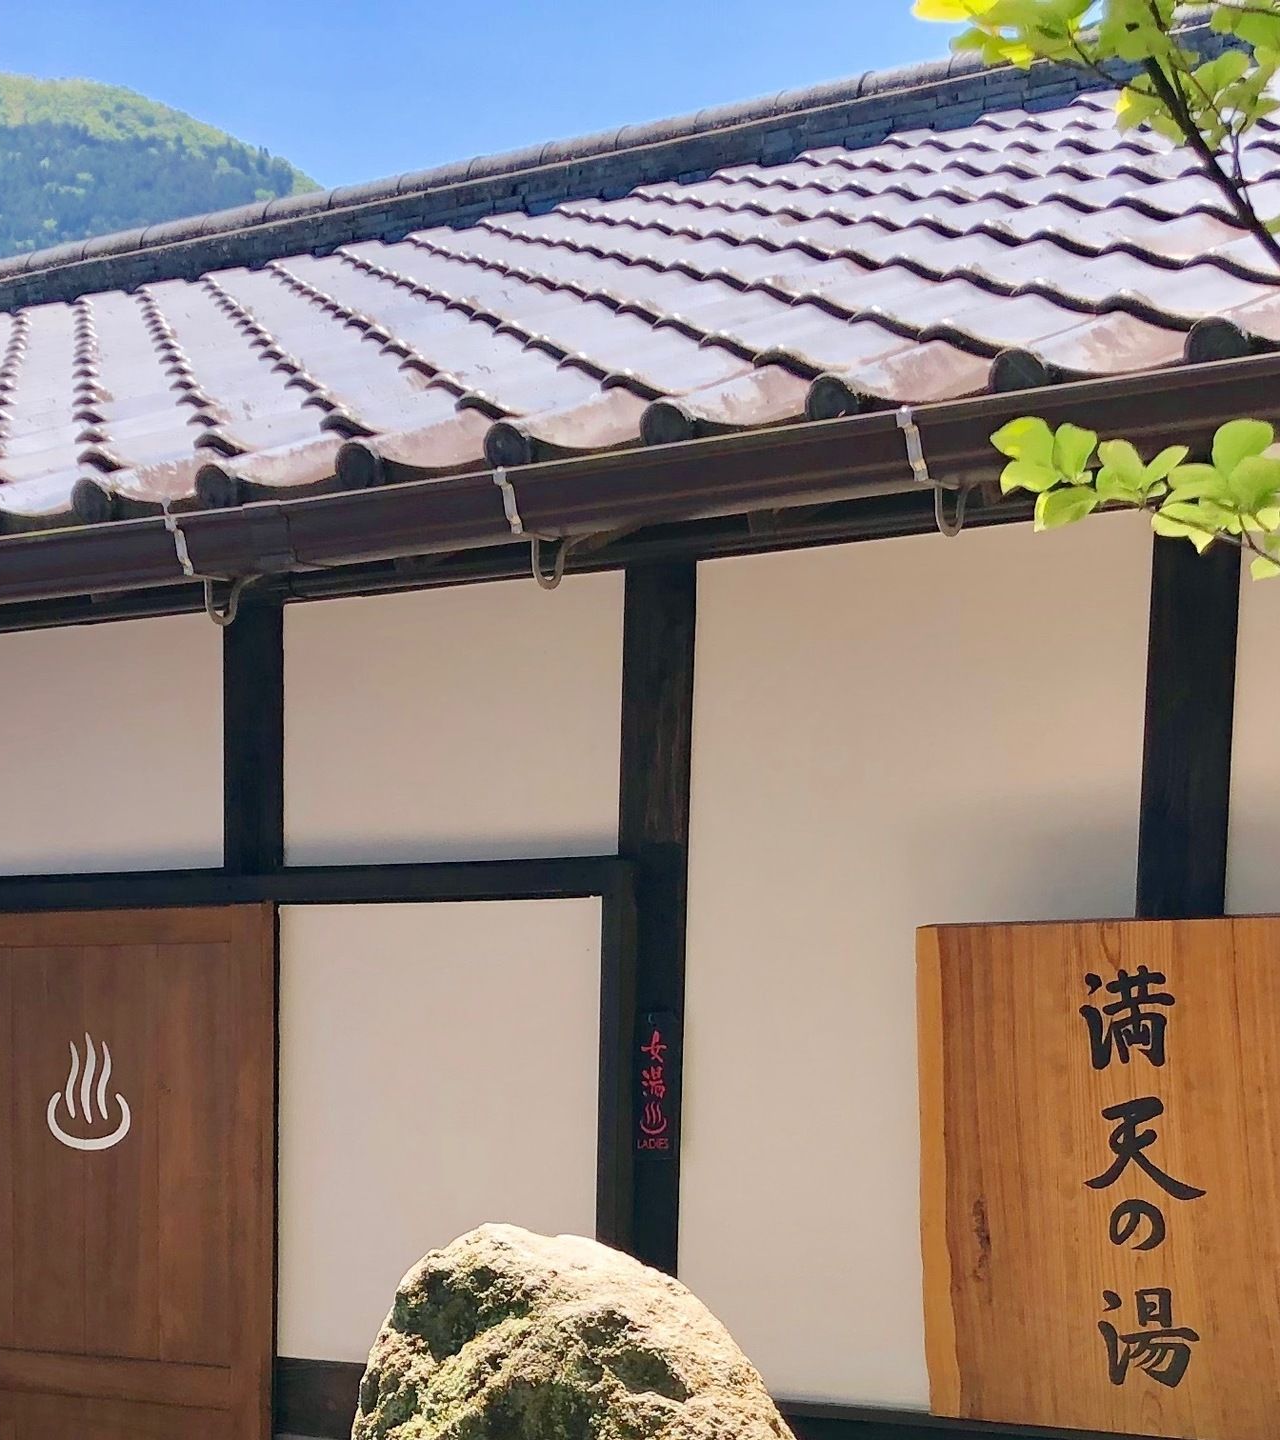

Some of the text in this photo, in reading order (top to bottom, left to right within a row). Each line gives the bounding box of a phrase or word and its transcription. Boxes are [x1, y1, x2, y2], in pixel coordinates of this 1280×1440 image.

[640, 1029, 668, 1099] 女湯
[1078, 964, 1207, 1388] 満天の湯
